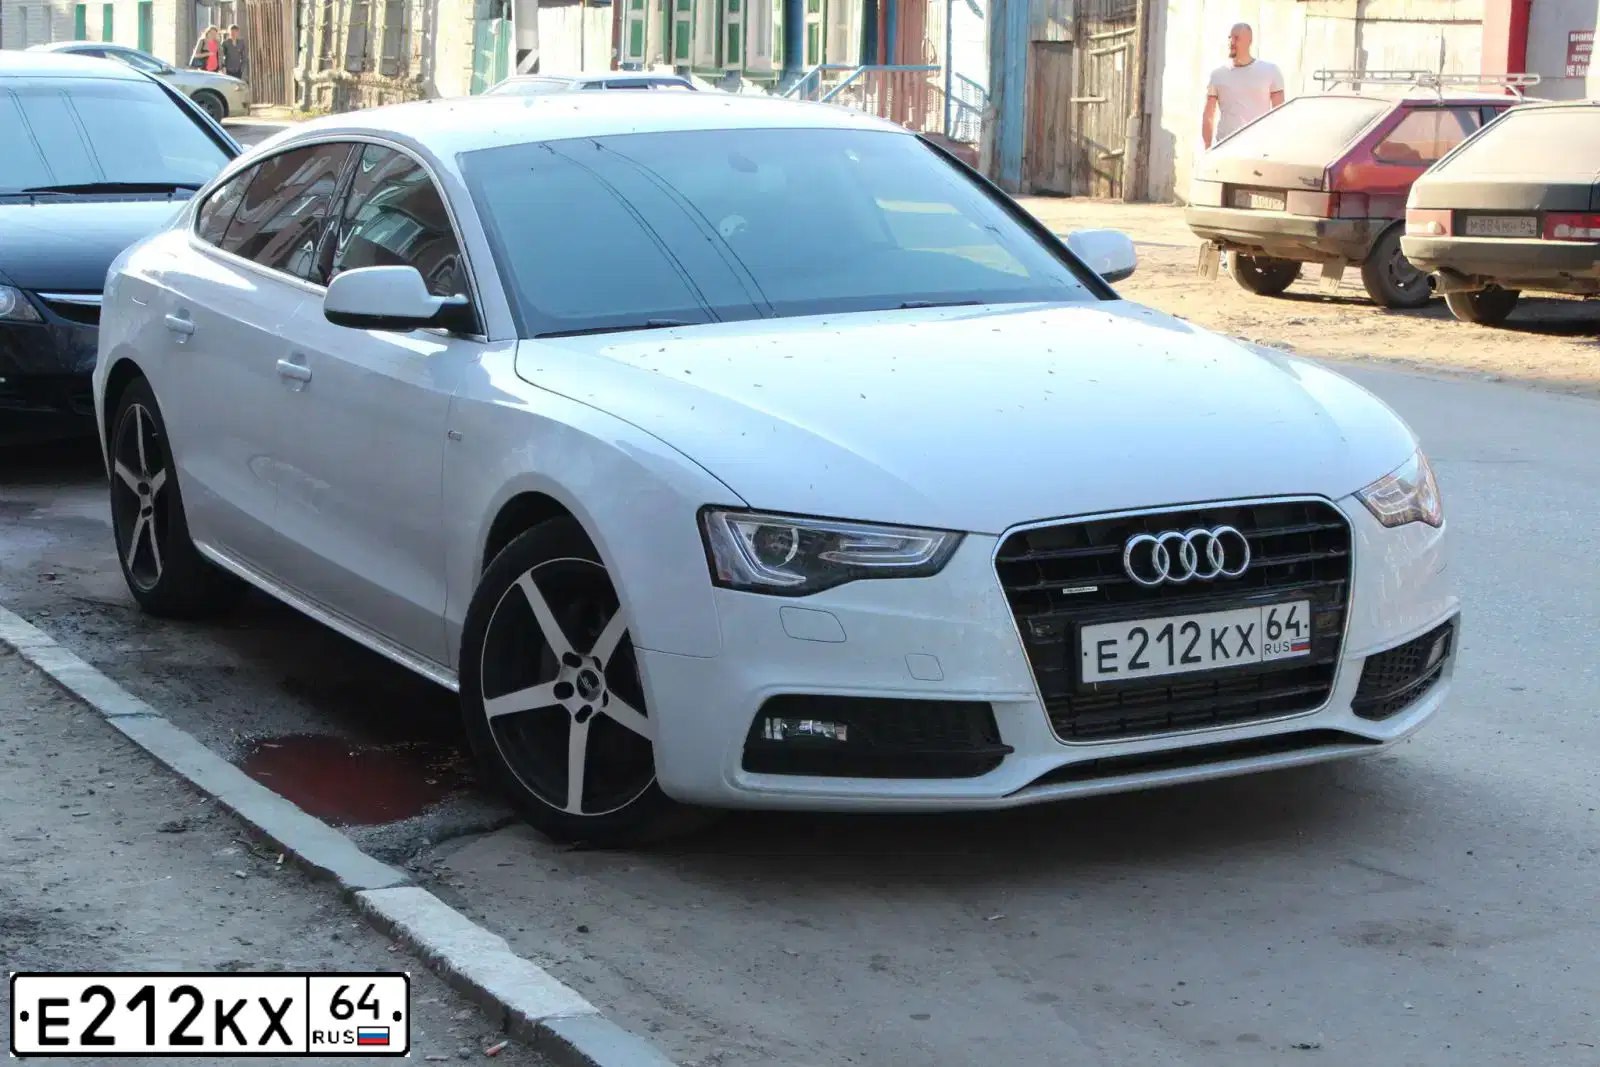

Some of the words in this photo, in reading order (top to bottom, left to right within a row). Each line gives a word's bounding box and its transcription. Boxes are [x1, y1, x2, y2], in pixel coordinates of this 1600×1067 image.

[1570, 33, 1594, 41] ВНИМ
[1097, 620, 1256, 674] Е212КХ
[1266, 605, 1301, 641] 64
[1263, 641, 1291, 656] RUS
